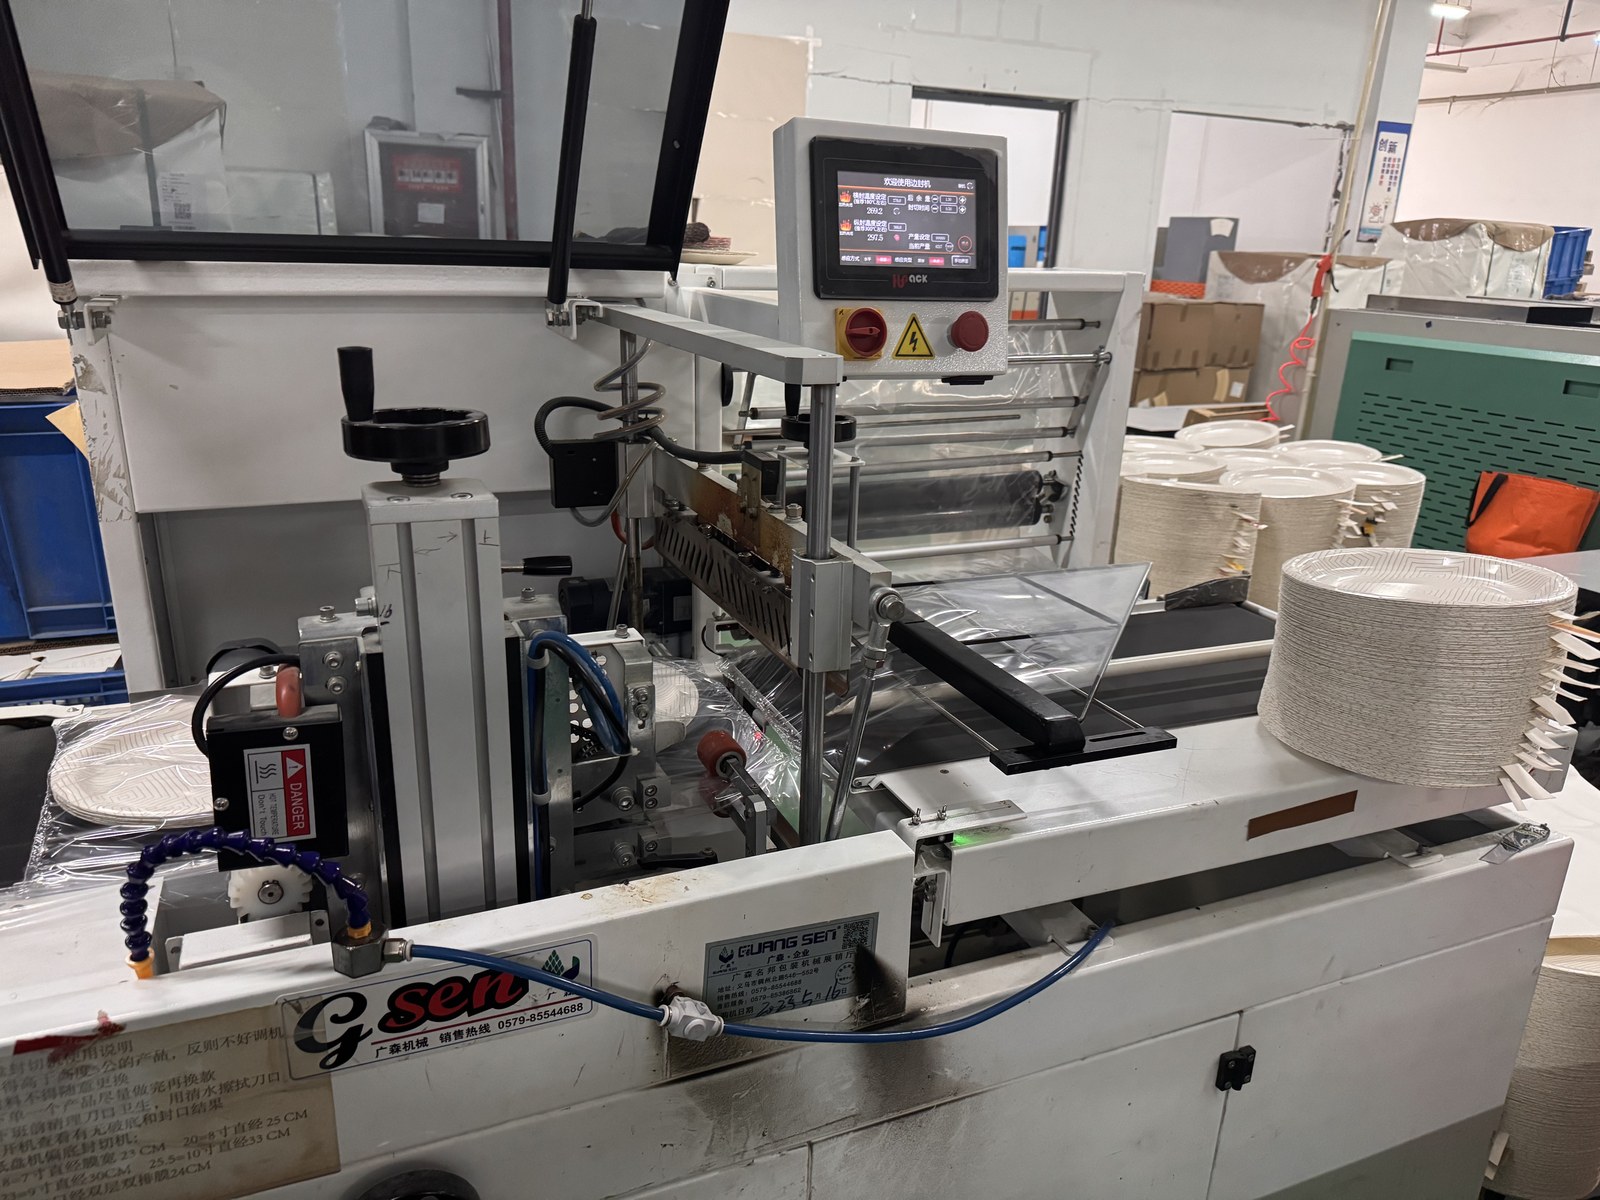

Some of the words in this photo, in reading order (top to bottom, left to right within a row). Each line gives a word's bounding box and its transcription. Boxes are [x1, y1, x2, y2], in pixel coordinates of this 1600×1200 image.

[1378, 138, 1398, 154] 创新
[289, 782, 306, 830] DANGER
[259, 816, 268, 837] Touch
[738, 935, 799, 958] GUANG
[802, 928, 837, 946] SEN
[375, 1036, 429, 1058] 广森机械
[438, 1022, 492, 1043] 销售热线
[497, 1002, 585, 1030] 0579-85544688
[0, 1073, 129, 1108] 料不得随意更换
[284, 1108, 309, 1123] CM
[265, 1127, 291, 1142] CM
